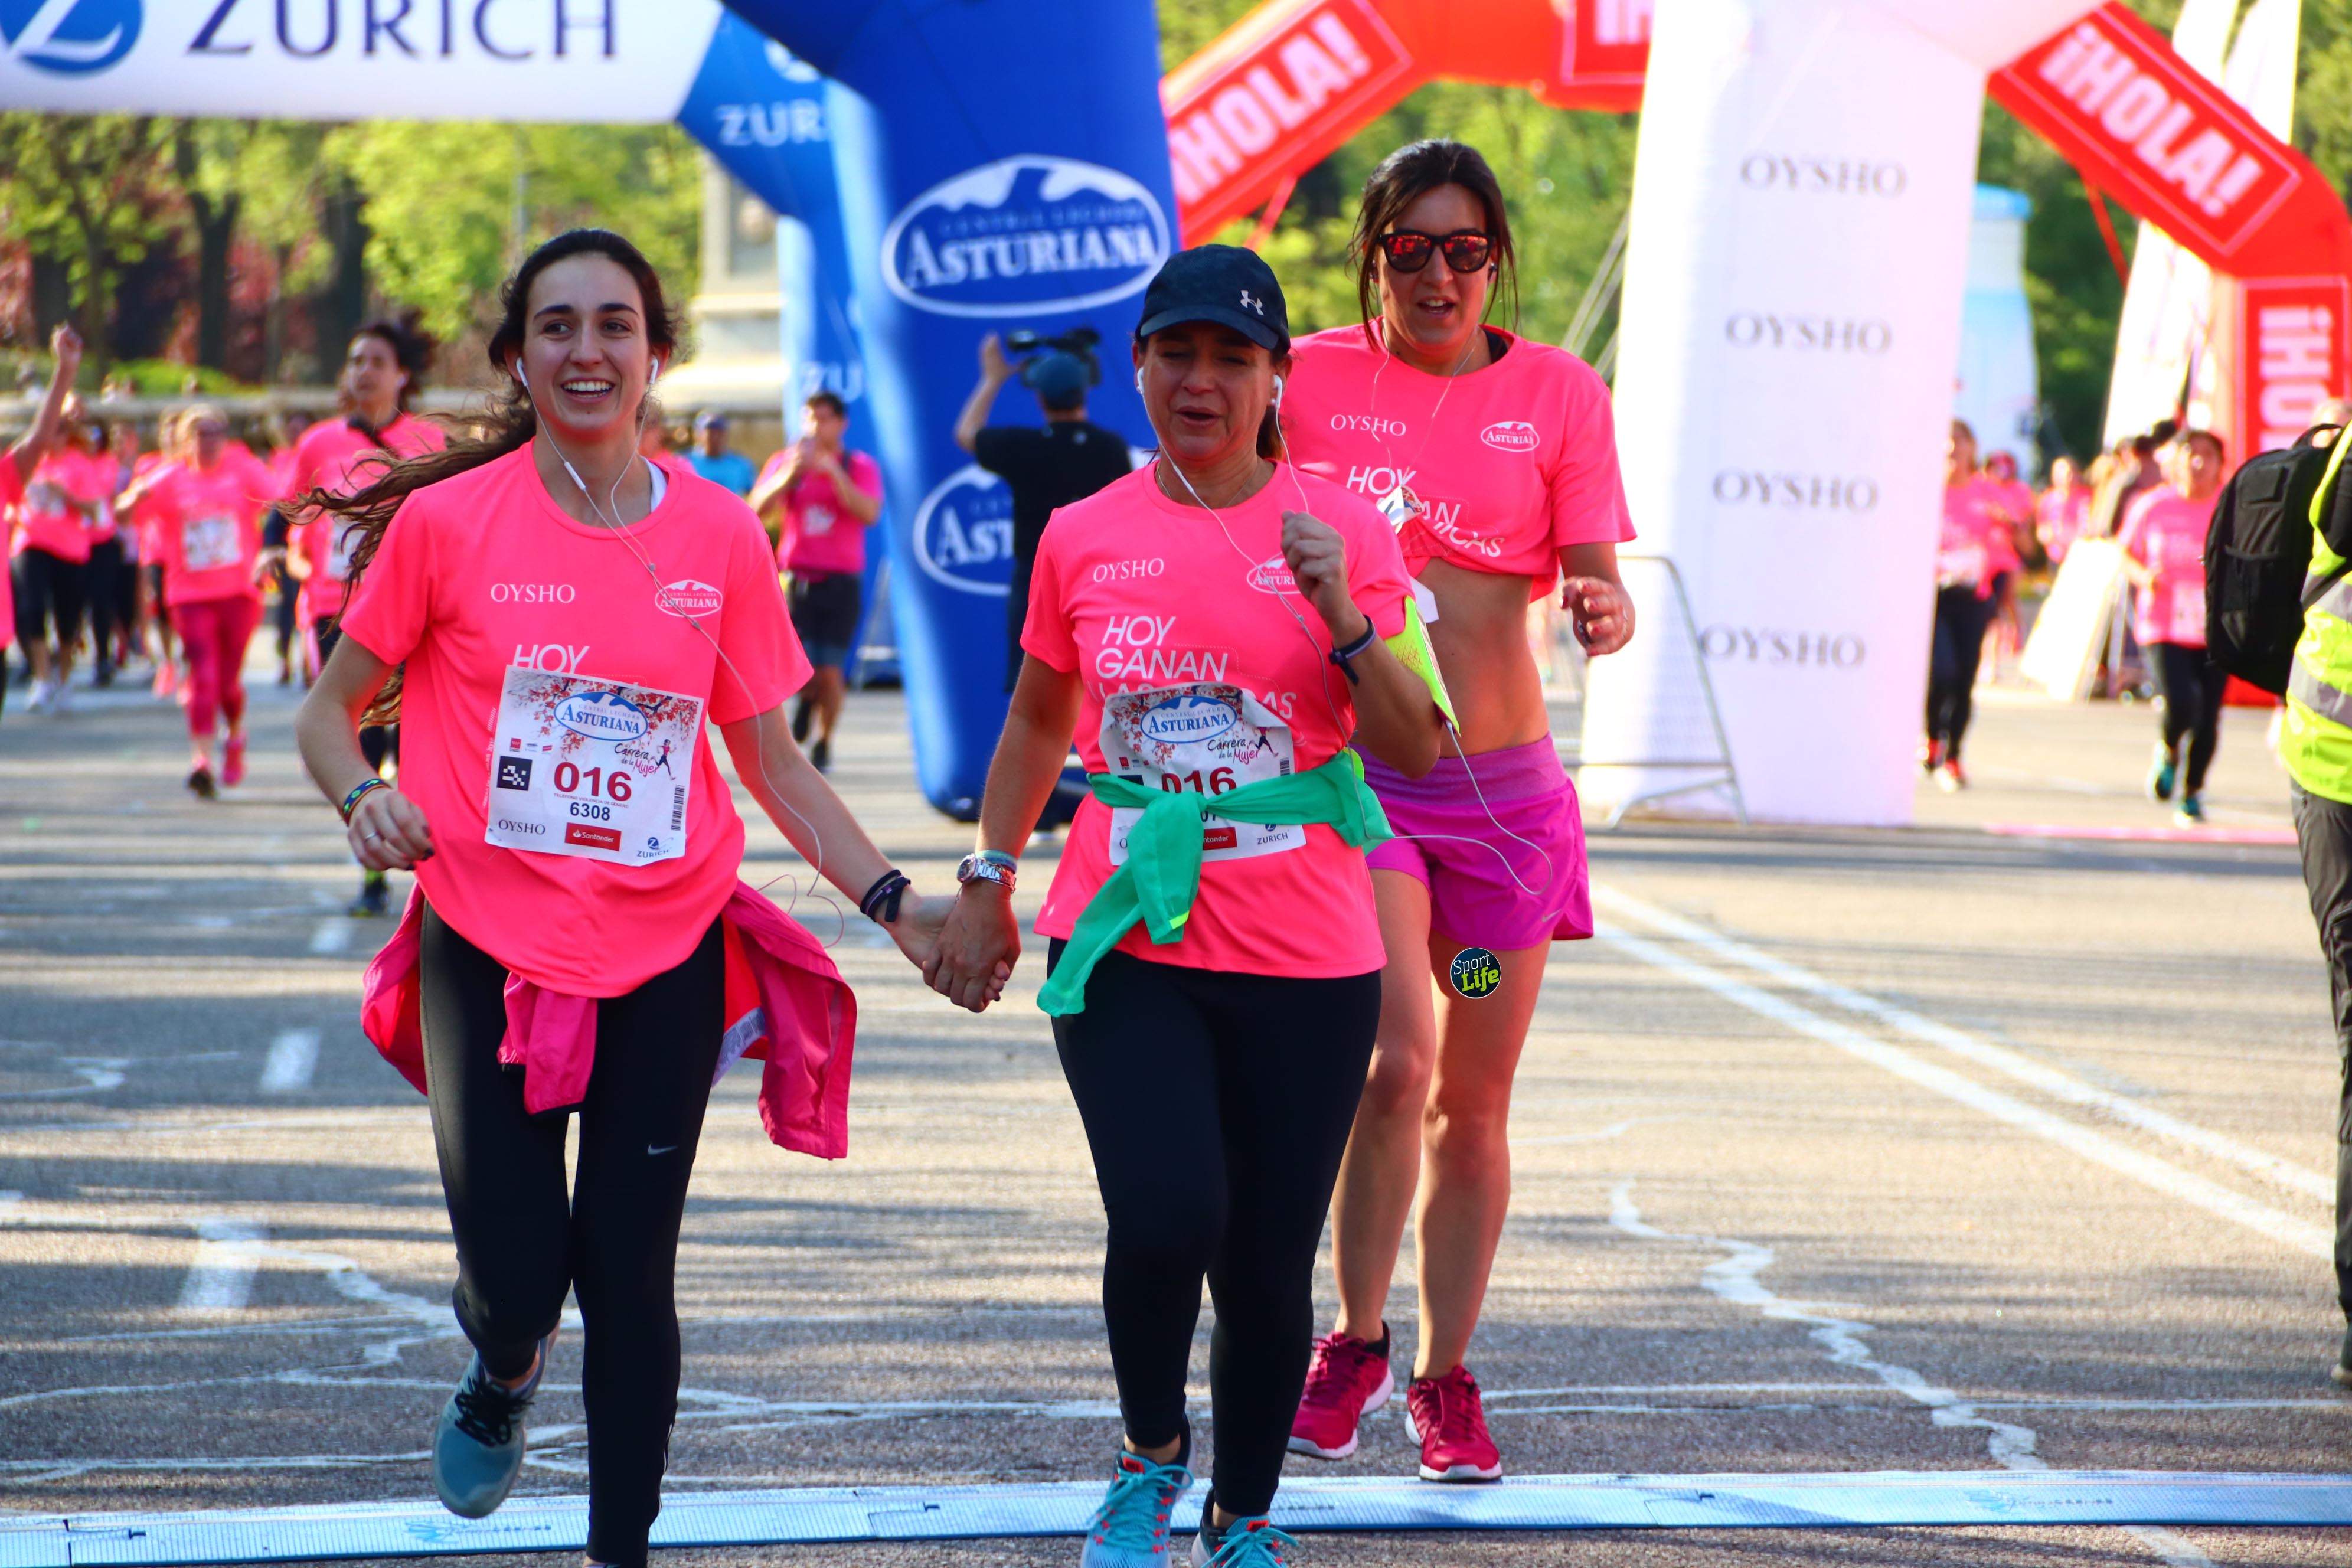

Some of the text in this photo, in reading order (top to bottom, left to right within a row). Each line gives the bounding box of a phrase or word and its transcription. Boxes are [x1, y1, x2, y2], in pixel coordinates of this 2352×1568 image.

[185, 0, 615, 59] ZURICH
[2038, 22, 2263, 218] ¡HOLA!
[1740, 153, 1907, 198] OYSHO
[903, 223, 1158, 289] ASTURIANA
[1725, 311, 1892, 355] OYSHO
[1331, 414, 1407, 437] OYSHO
[1713, 468, 1878, 513] OYSHO
[1093, 558, 1165, 583] OYSHO
[491, 583, 575, 604] OYSHO
[1101, 616, 1176, 646] HOY
[512, 643, 590, 674] HOY
[1698, 624, 1866, 669] OYSHO
[1096, 648, 1228, 681] GANAN
[561, 703, 640, 734] ASTURIANA
[1148, 713, 1229, 734] ASTURIANA
[614, 743, 649, 760] Carrera
[1207, 739, 1246, 752] Carrera
[1226, 750, 1233, 759] la
[1232, 749, 1260, 765] Mujer
[553, 761, 632, 802] 016
[633, 760, 660, 778] Mujer
[570, 802, 610, 821] 6308
[498, 819, 545, 835] OYSHO
[582, 831, 614, 843] Santander
[1256, 832, 1288, 845] ZURICH
[636, 849, 669, 858] ZURICH
